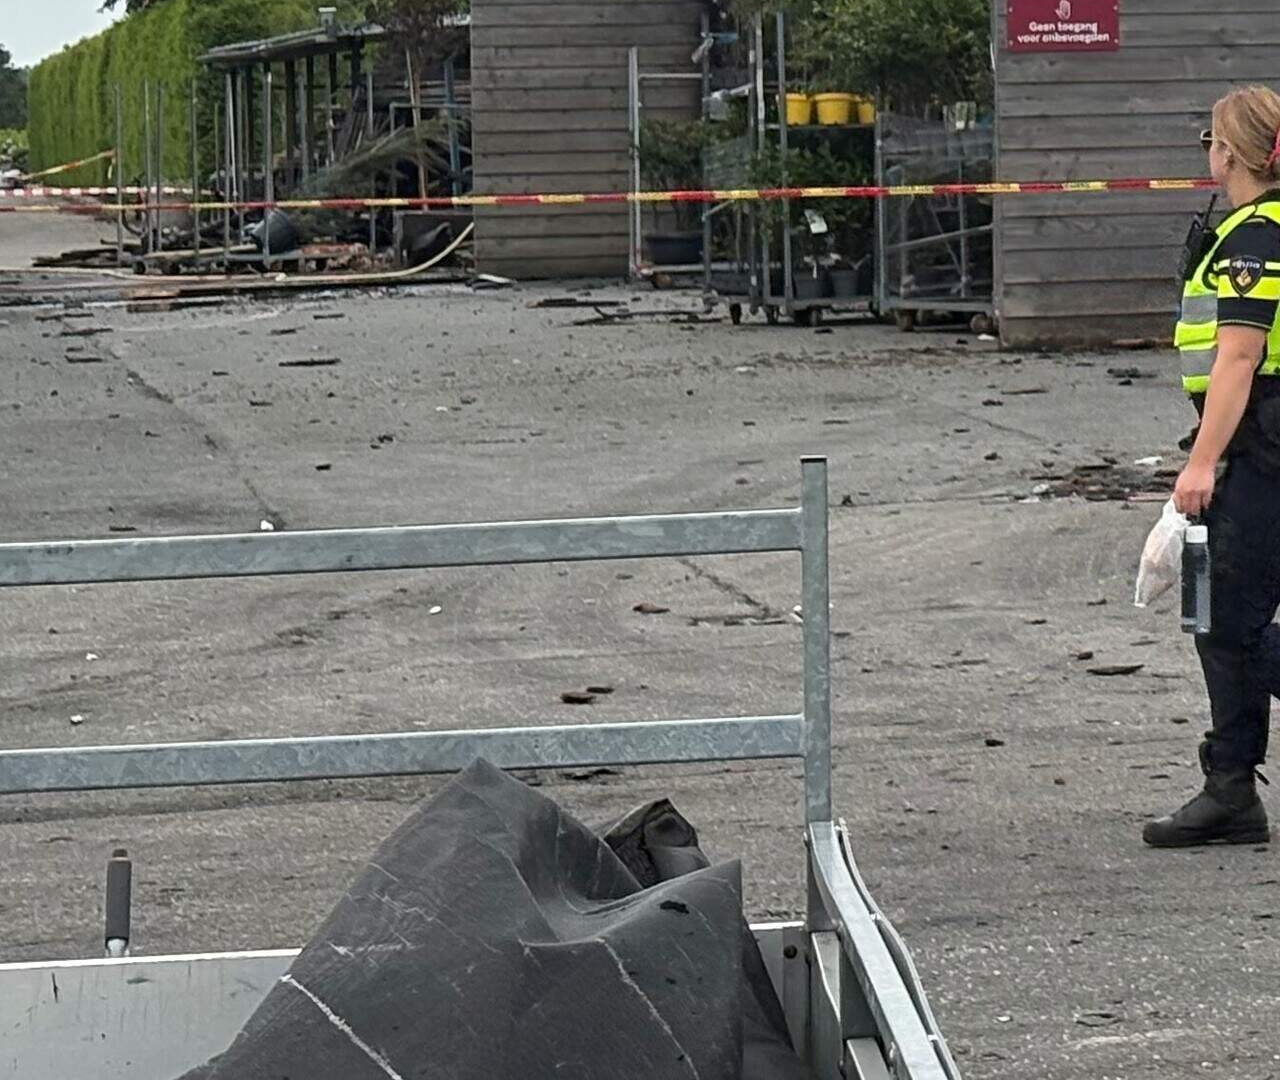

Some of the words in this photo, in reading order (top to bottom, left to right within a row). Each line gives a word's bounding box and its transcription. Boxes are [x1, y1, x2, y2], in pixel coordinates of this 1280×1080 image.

[1029, 21, 1056, 32] Geen
[1057, 21, 1098, 35] toegang
[1017, 34, 1041, 44] voor
[1042, 31, 1110, 45] onbevoegden
